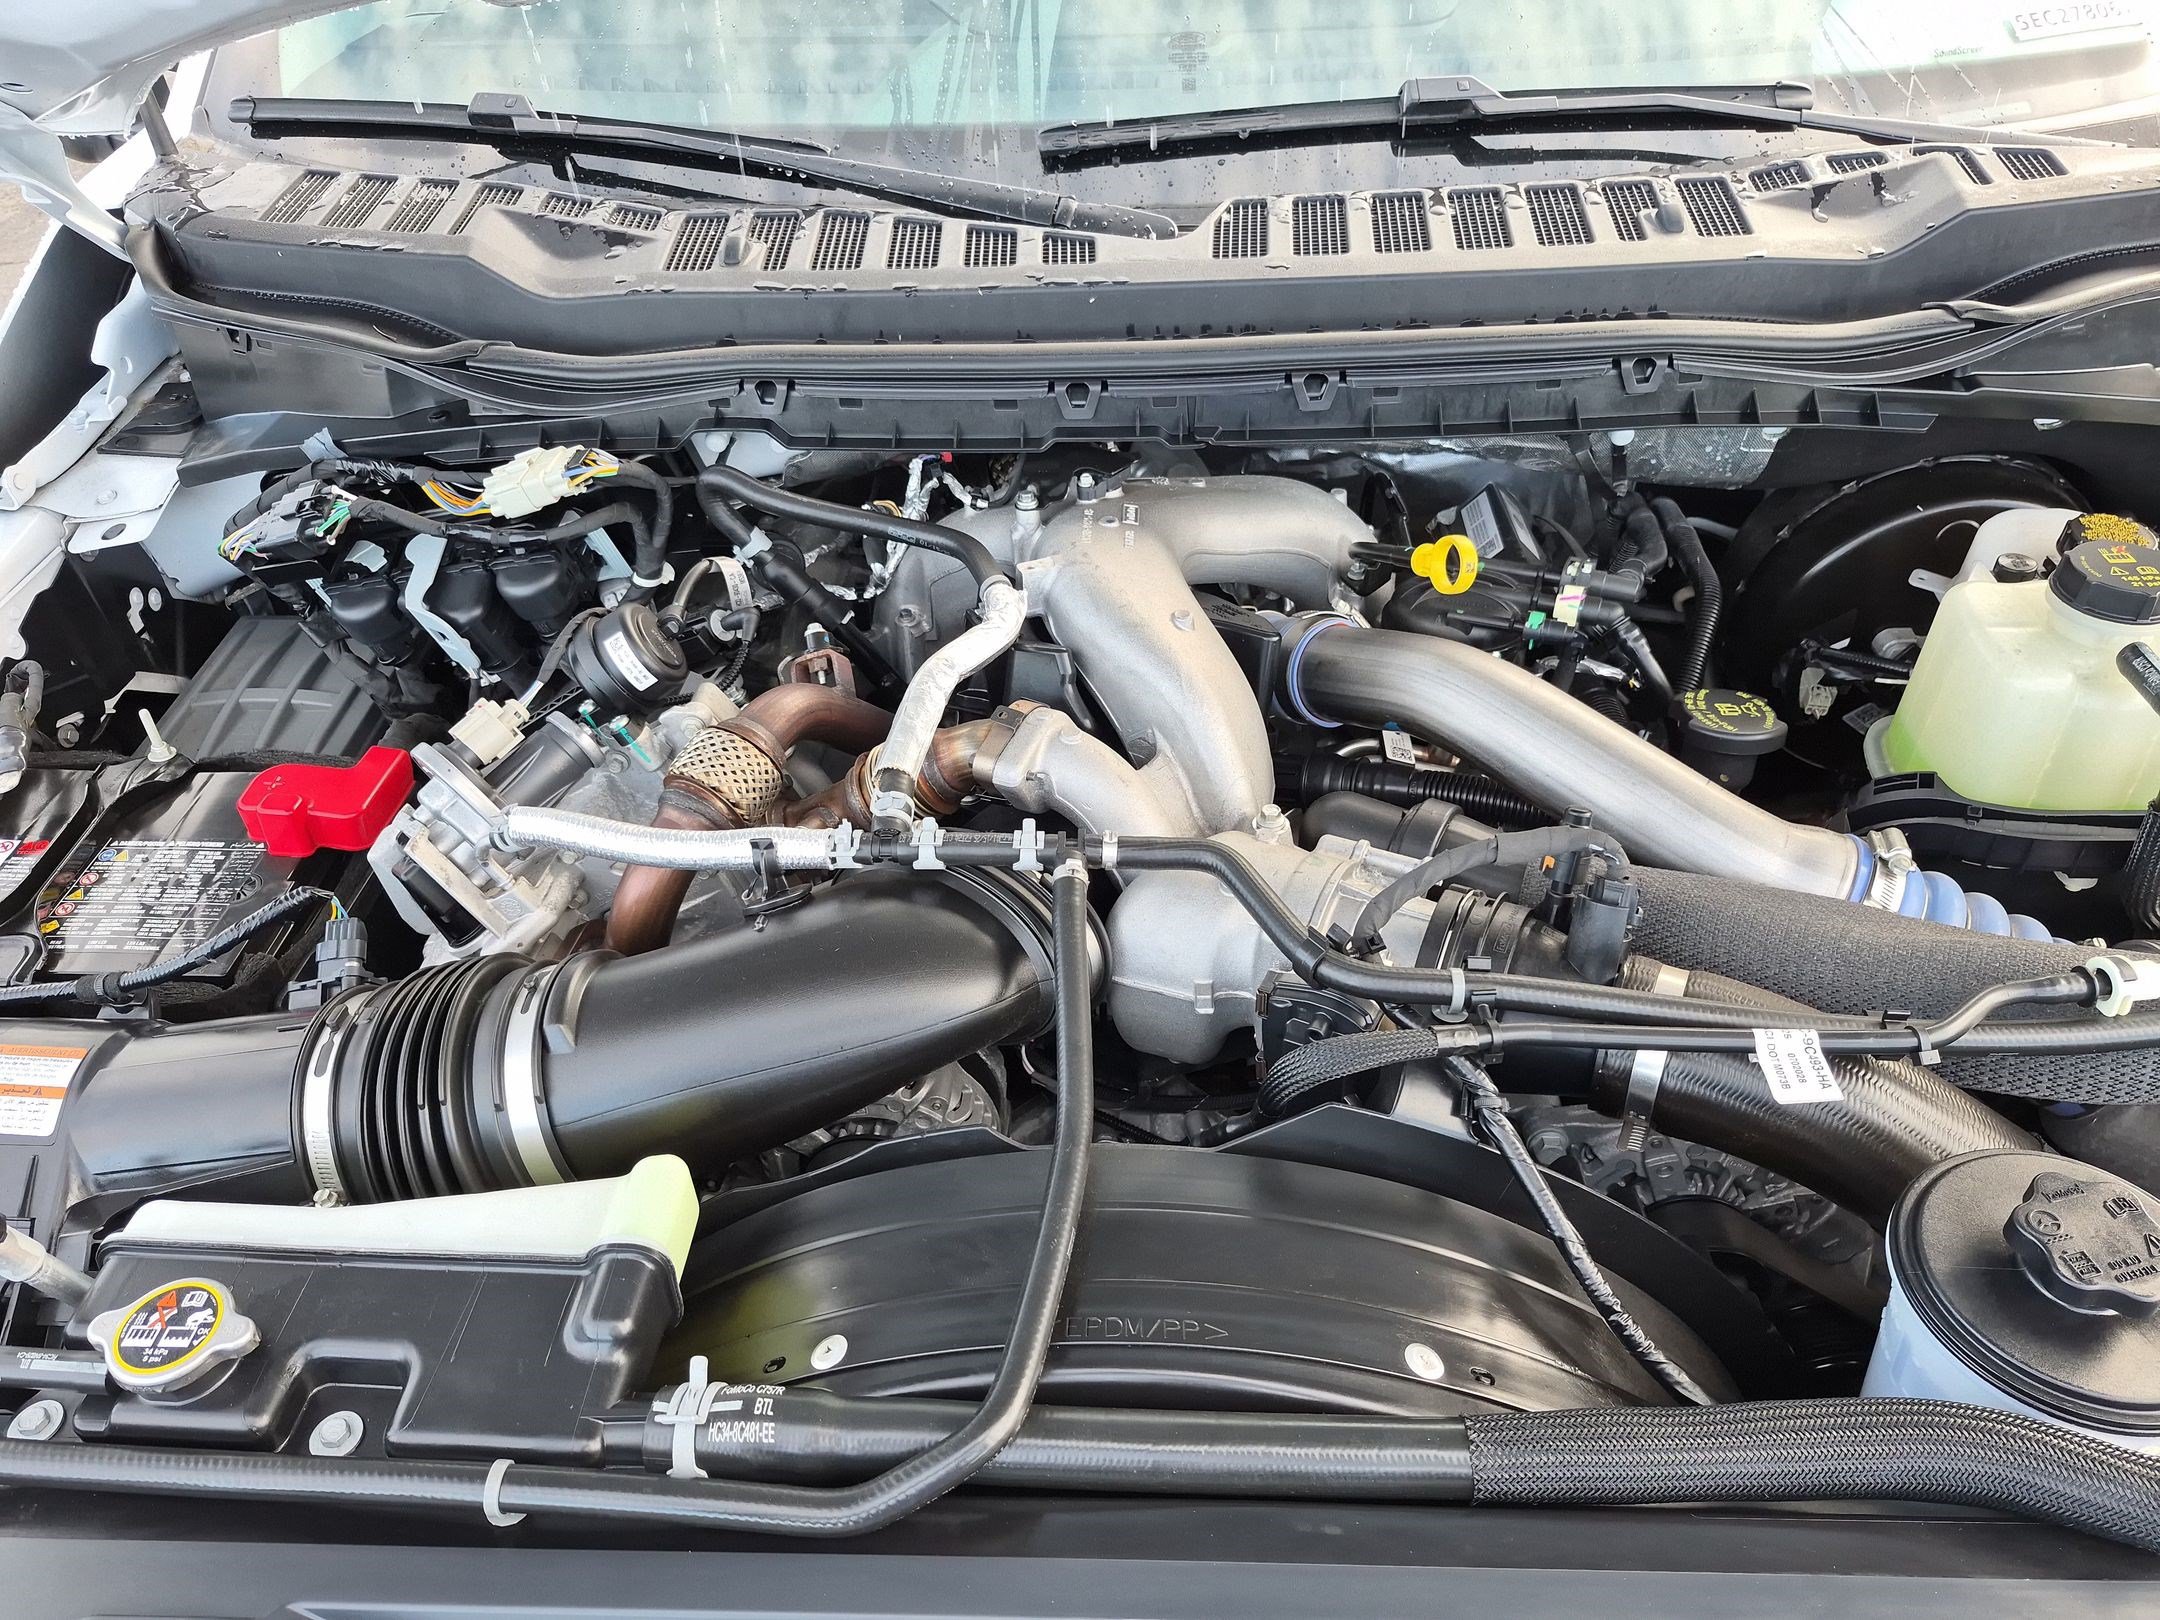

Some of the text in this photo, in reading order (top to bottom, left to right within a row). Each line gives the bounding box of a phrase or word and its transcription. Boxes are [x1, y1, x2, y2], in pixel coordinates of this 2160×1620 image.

[197, 1327, 211, 1335] OK
[721, 1384, 755, 1396] FoMoCo
[753, 1397, 774, 1416] BTL
